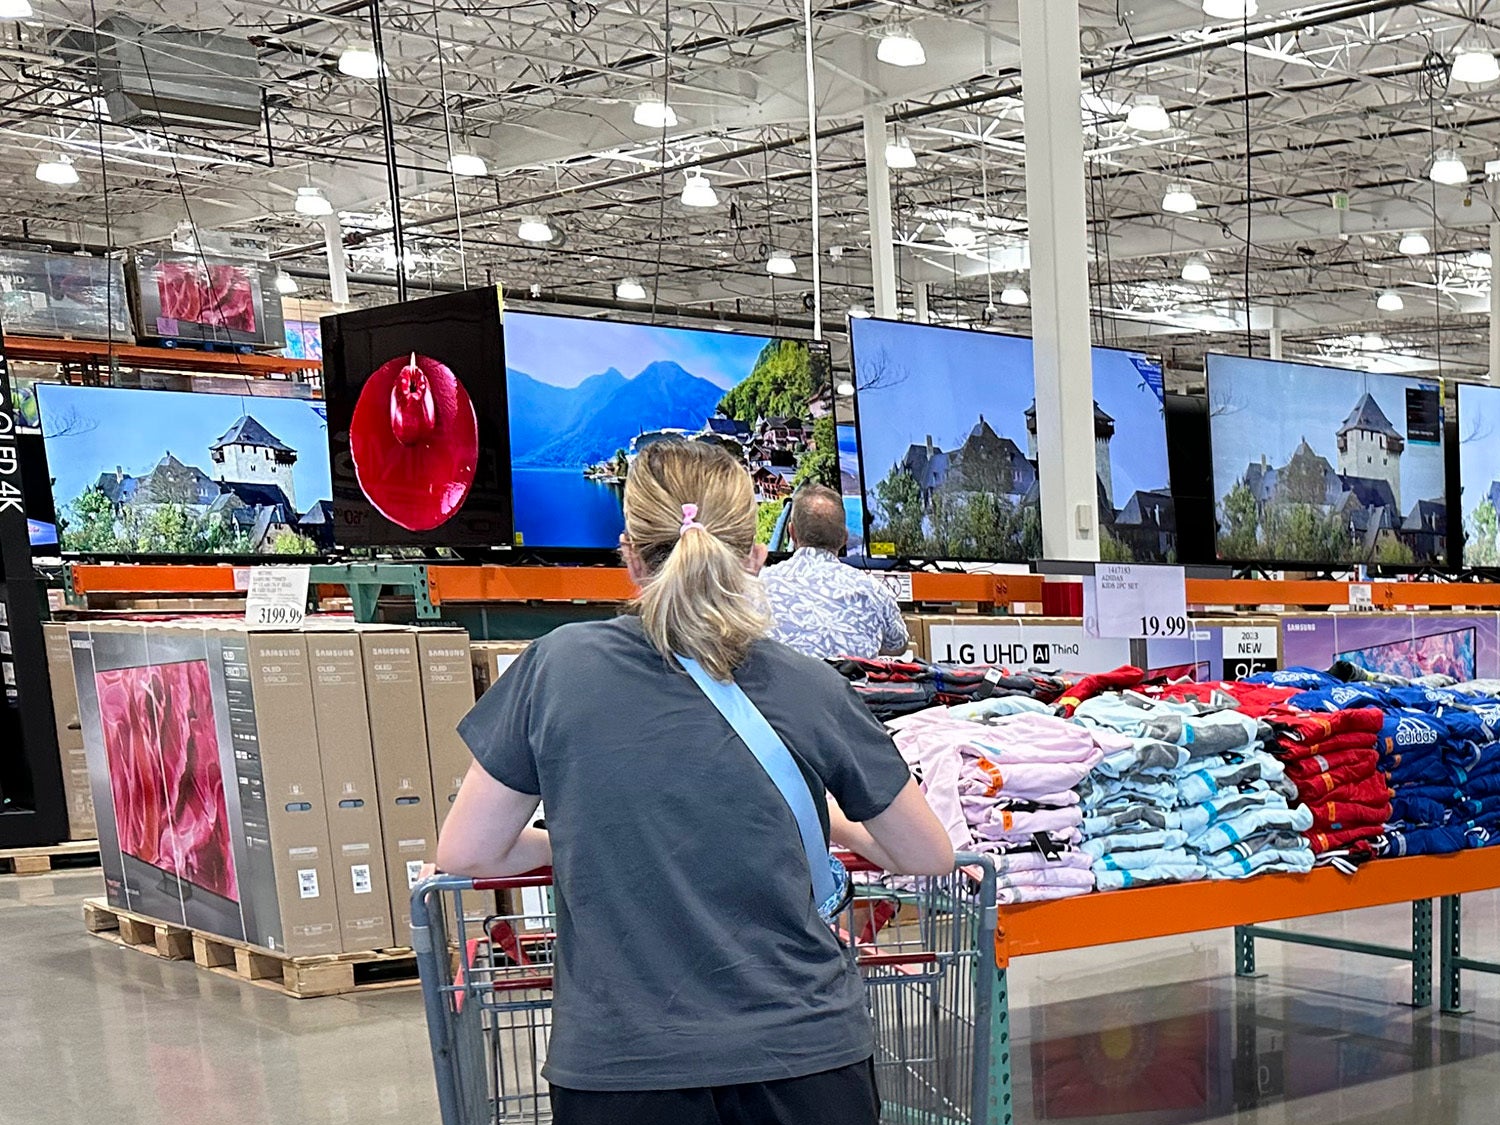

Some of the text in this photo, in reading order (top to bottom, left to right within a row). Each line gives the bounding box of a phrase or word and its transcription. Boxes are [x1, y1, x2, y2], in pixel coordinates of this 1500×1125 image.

[258, 607, 302, 624] 3199.99
[1140, 615, 1186, 636] 19.99
[1287, 623, 1316, 631] SAMSUNG
[259, 648, 301, 657] SAMSUNG
[315, 649, 354, 657] SAMSUNG
[372, 647, 410, 655] SAMSUNG
[428, 649, 464, 657] SAMSUNG
[983, 643, 1028, 664] UHD
[1034, 646, 1049, 663] AI
[1052, 643, 1079, 656] ThinQ
[1238, 643, 1262, 654] NEW
[1396, 729, 1437, 746] adidas
